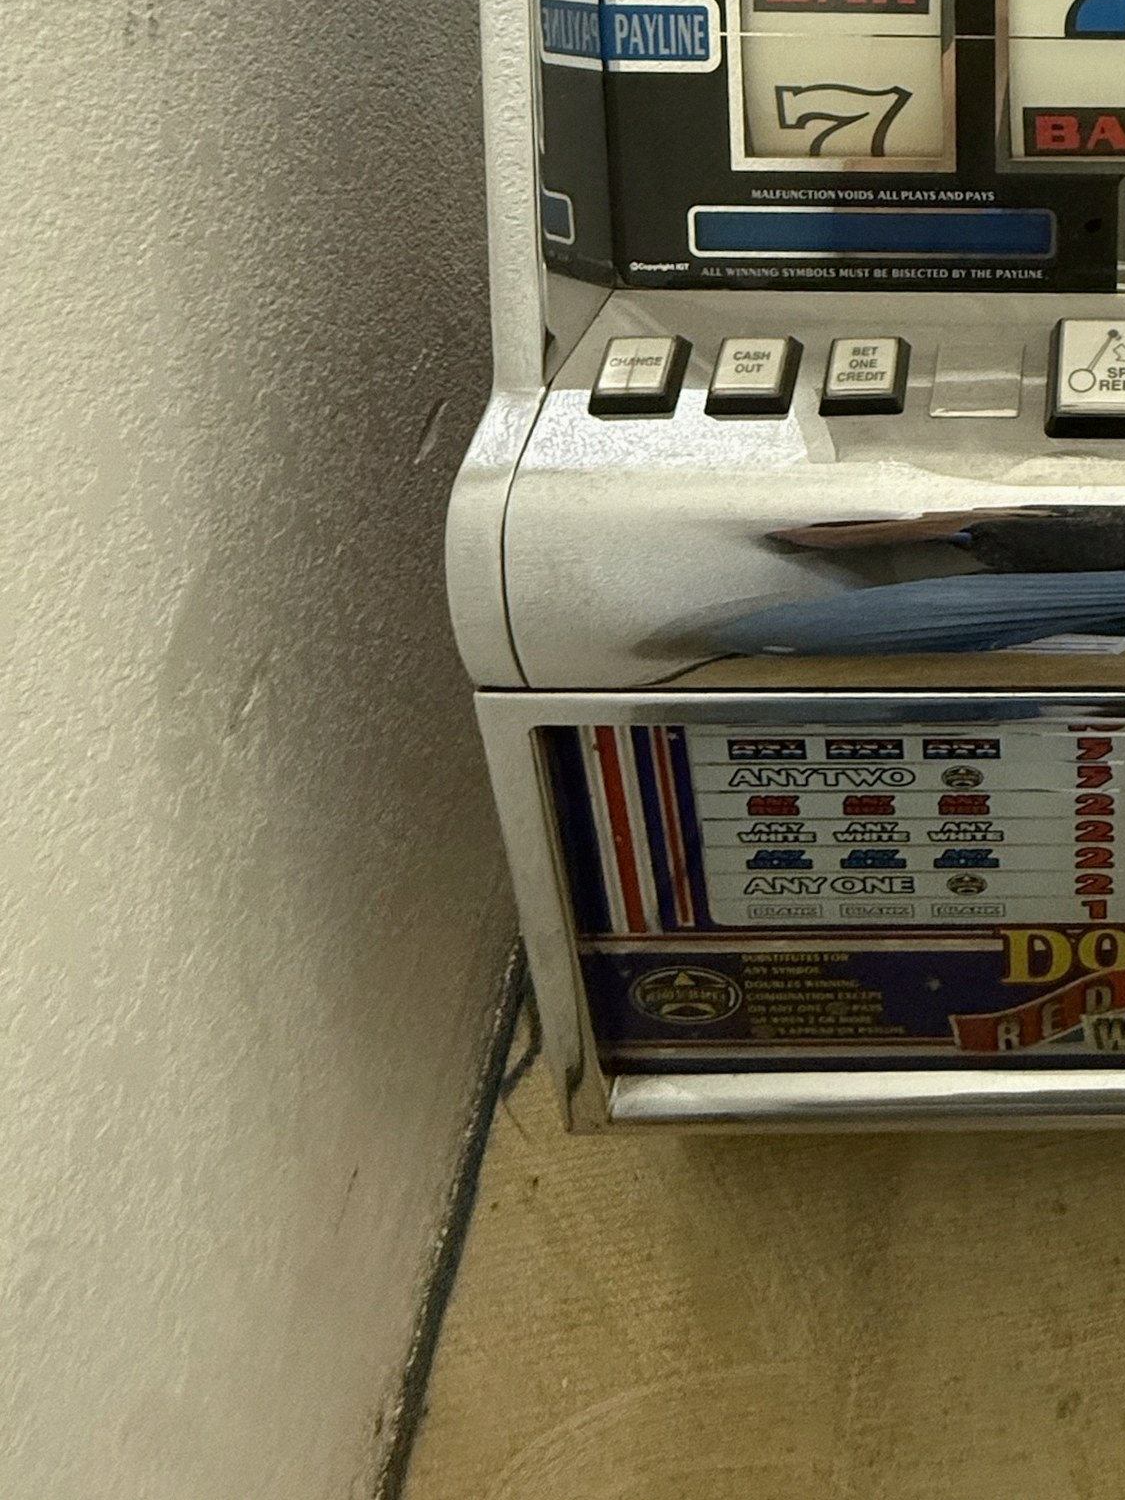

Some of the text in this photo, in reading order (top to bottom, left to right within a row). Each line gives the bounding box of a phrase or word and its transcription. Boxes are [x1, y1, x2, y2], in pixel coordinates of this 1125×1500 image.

[613, 15, 706, 57] PAYLINE
[775, 84, 913, 157] 7
[751, 189, 996, 201] MALFUNCTION VOIDS ALL PLAYS AND PAYS
[701, 267, 723, 278] ALL
[725, 267, 779, 278] WINNING
[781, 267, 837, 278] SYMBOLS
[839, 267, 870, 278] MUST
[873, 268, 888, 279] BE
[891, 268, 947, 279] BISECTED
[951, 268, 967, 279] BY
[970, 268, 992, 279] THE
[733, 350, 771, 361] CASH
[851, 346, 879, 357] BET
[609, 356, 663, 368] CHANGE
[735, 363, 763, 373] OUT
[848, 358, 878, 369] ONE
[836, 371, 887, 382] CREDIT
[729, 767, 916, 788] ANY TWO
[744, 877, 915, 895] ANY ONE
[999, 983, 1112, 1052] RED
